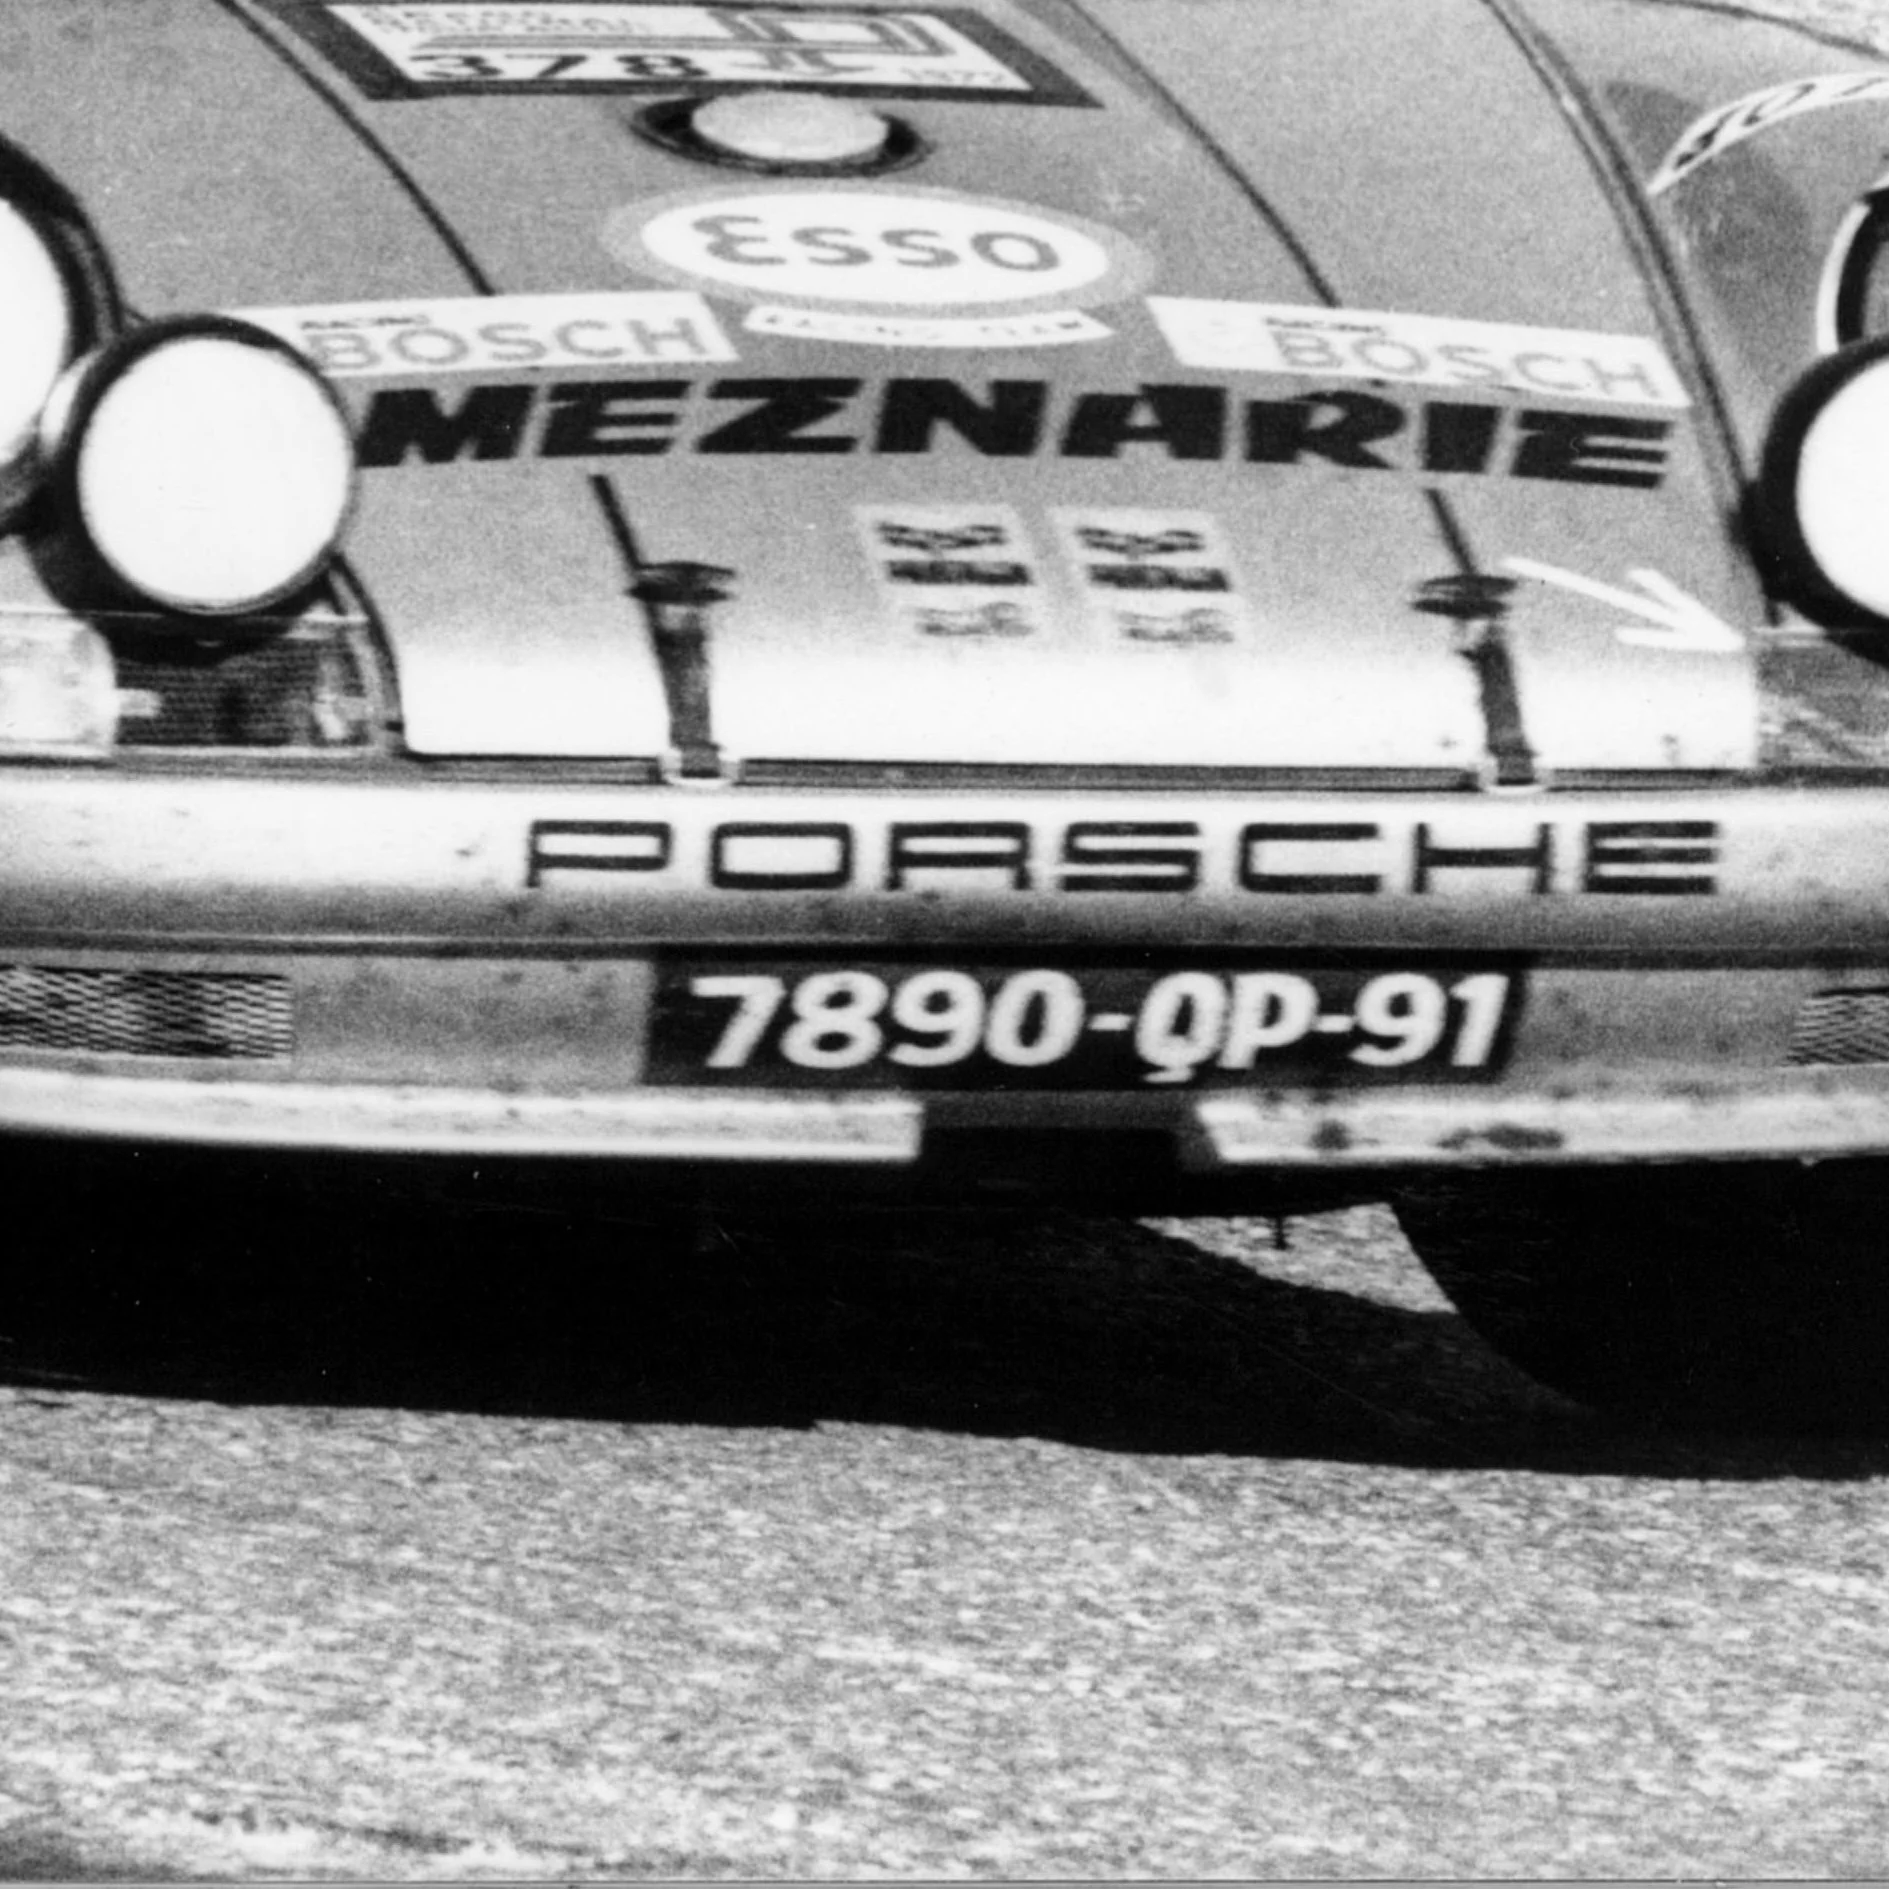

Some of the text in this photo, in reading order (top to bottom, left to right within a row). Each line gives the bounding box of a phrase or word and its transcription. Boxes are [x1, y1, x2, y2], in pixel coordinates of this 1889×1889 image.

[410, 51, 711, 84] 378
[312, 317, 712, 371] BOSCH
[1271, 329, 1661, 400] BOSCH
[355, 376, 1675, 490] MEZNARIE
[527, 819, 1722, 896] PORSCHE
[691, 970, 1510, 1084] 7890-QP-91
